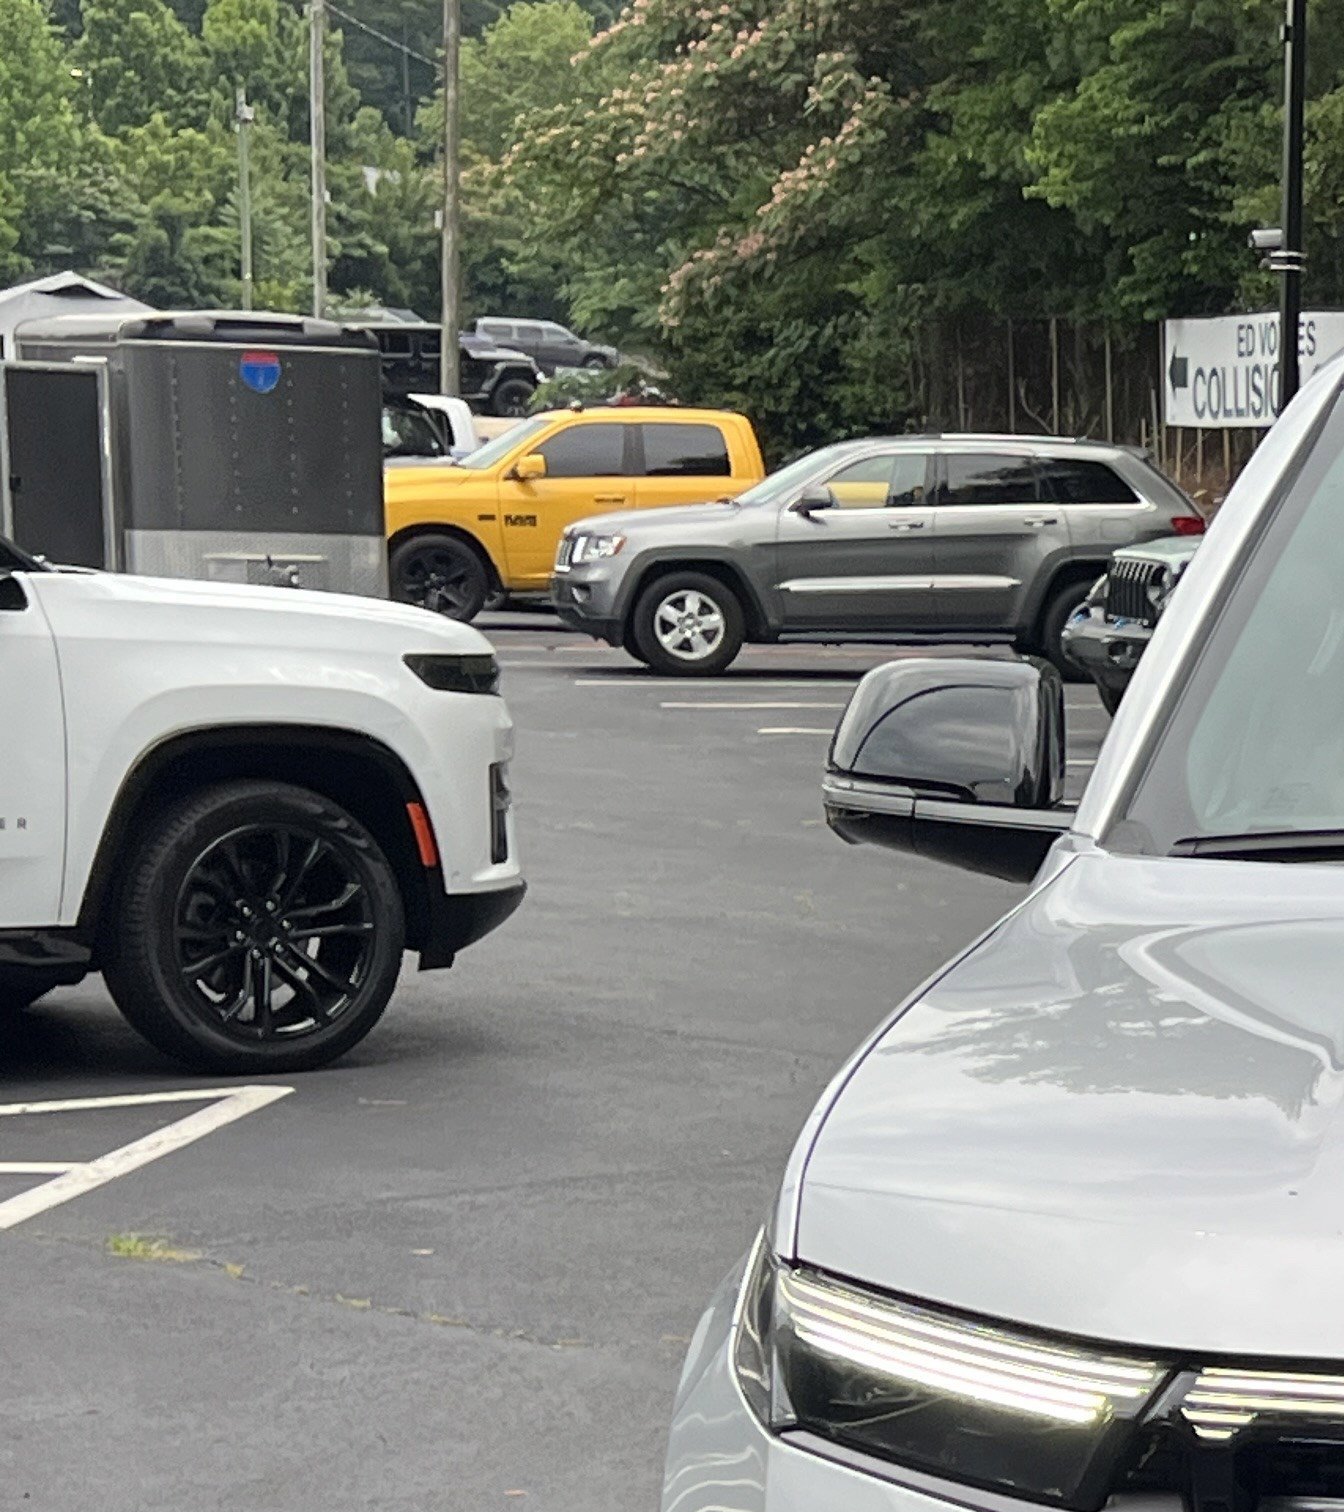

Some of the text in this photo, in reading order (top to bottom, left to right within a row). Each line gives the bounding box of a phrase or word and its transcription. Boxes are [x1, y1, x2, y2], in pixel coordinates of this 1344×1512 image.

[1237, 320, 1317, 358] ED VOES
[1193, 363, 1282, 419] COLLISIO
